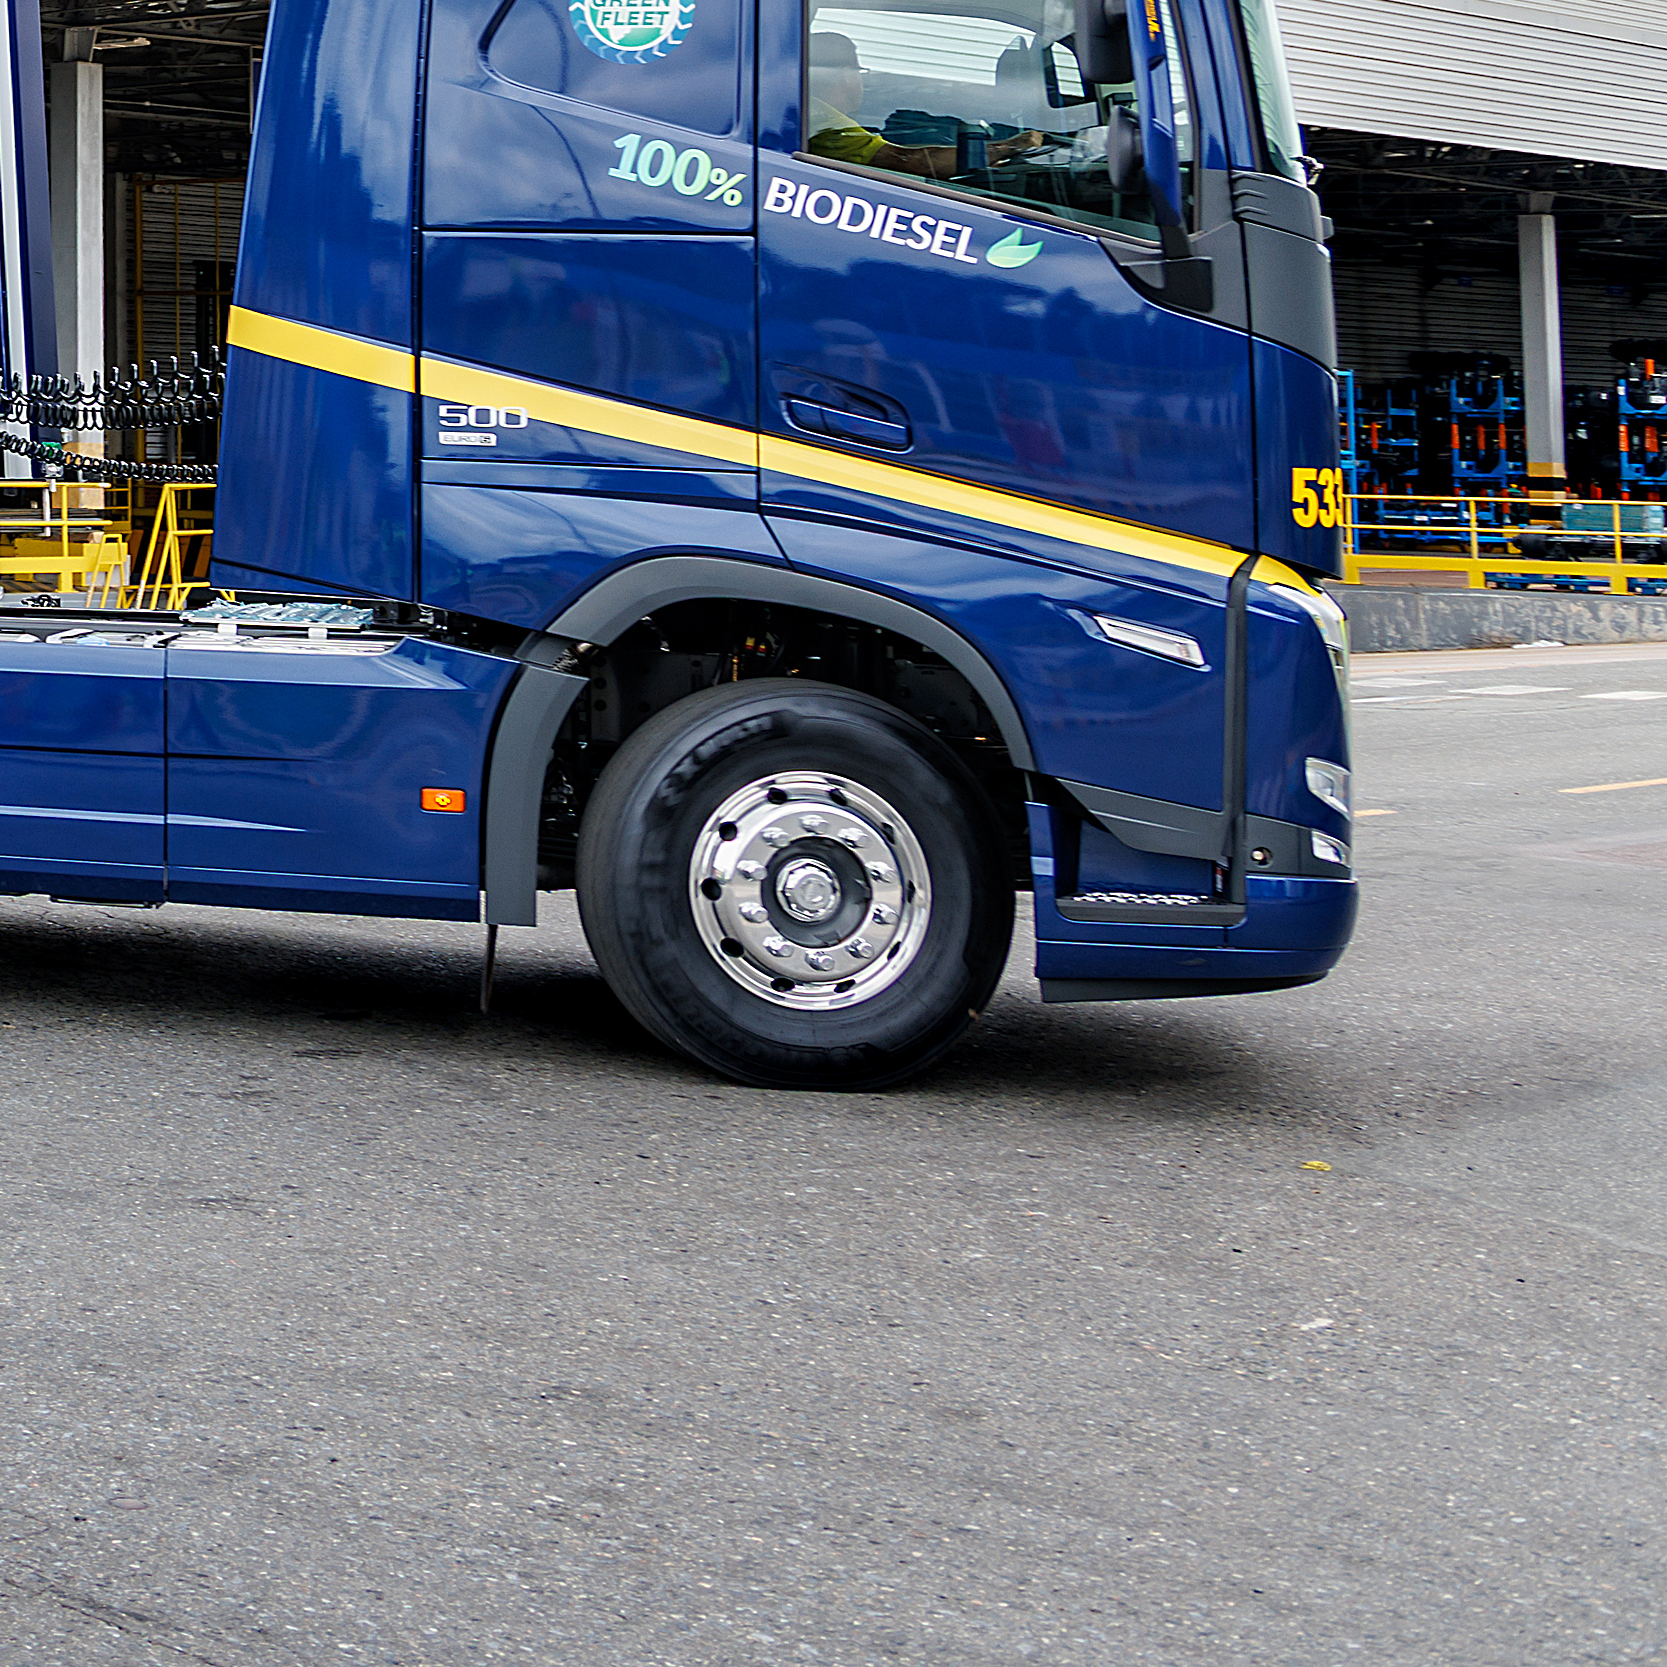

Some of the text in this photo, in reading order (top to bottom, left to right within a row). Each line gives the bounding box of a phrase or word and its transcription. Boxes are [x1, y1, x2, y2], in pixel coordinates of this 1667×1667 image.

[600, 11, 670, 26] FLEET
[608, 133, 978, 264] 100% BIODIESEL
[438, 405, 528, 429] 500
